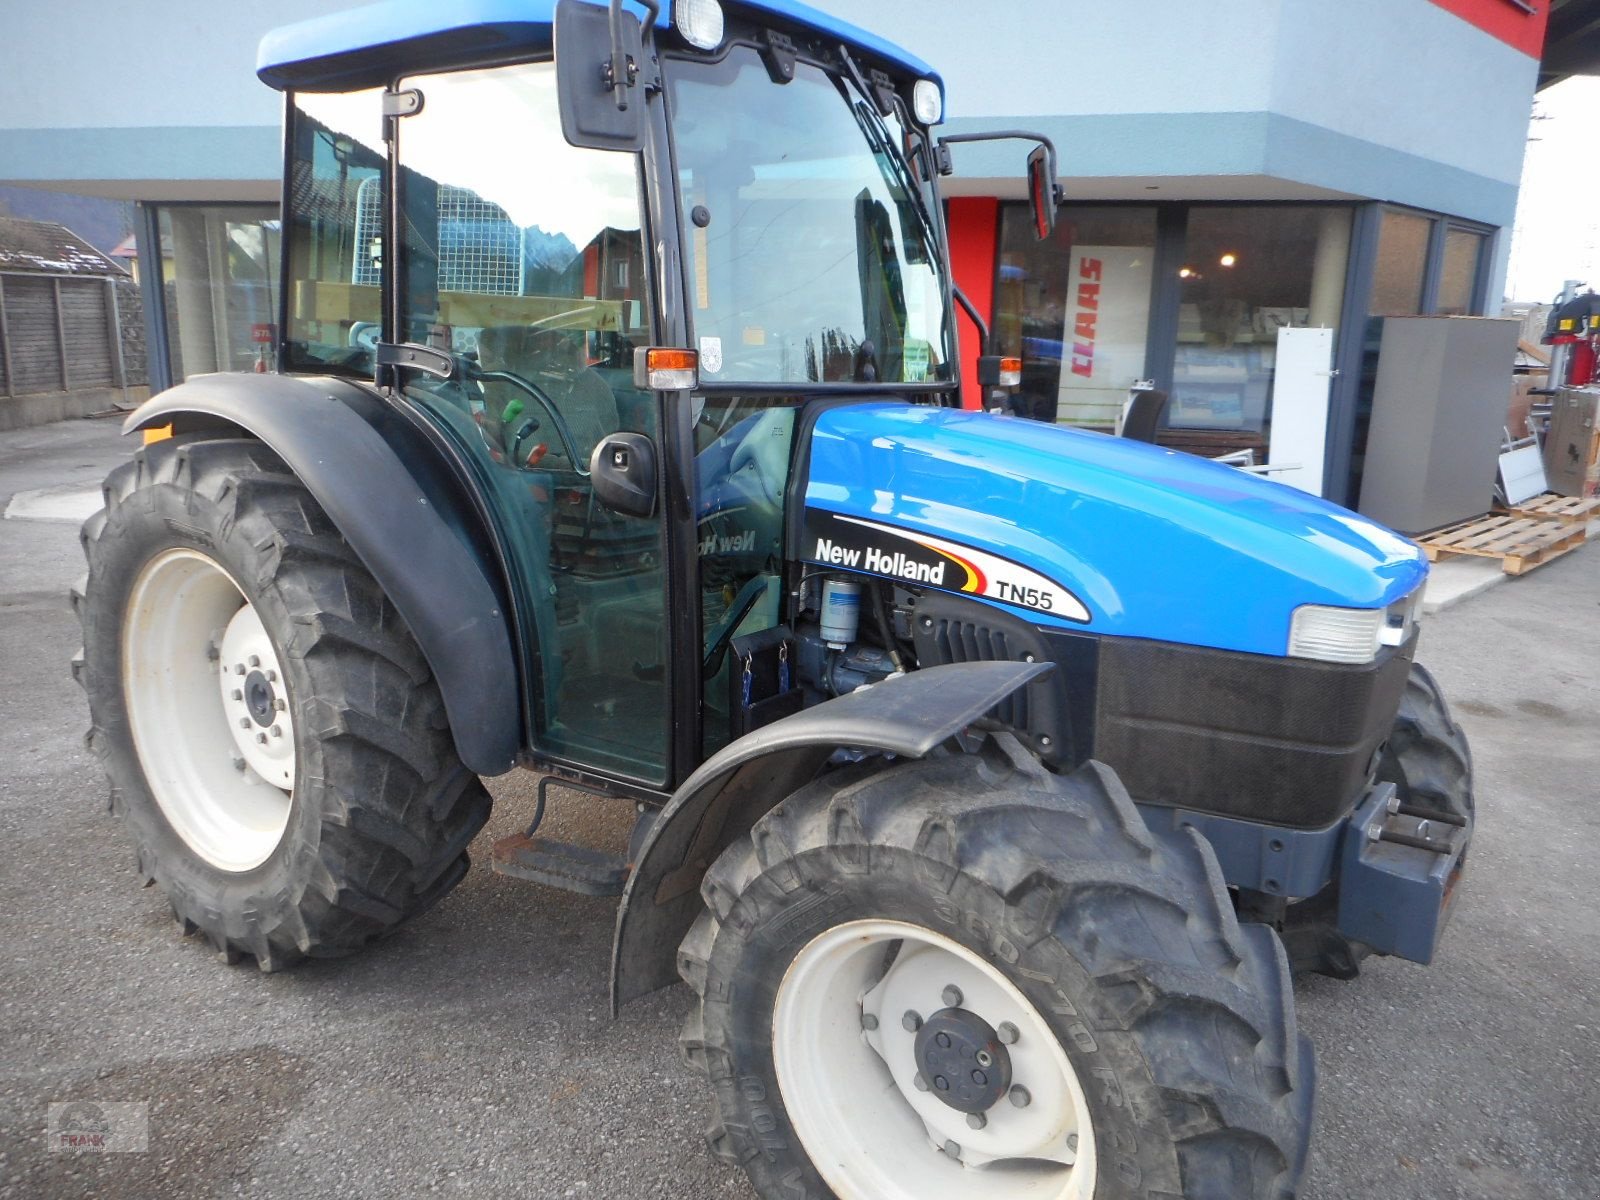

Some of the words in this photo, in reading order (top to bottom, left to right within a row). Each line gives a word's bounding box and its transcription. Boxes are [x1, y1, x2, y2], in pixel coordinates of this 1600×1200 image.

[1072, 257, 1102, 378] CLAAS
[815, 538, 860, 567] New
[864, 548, 945, 585] Holland
[996, 580, 1053, 610] TN55
